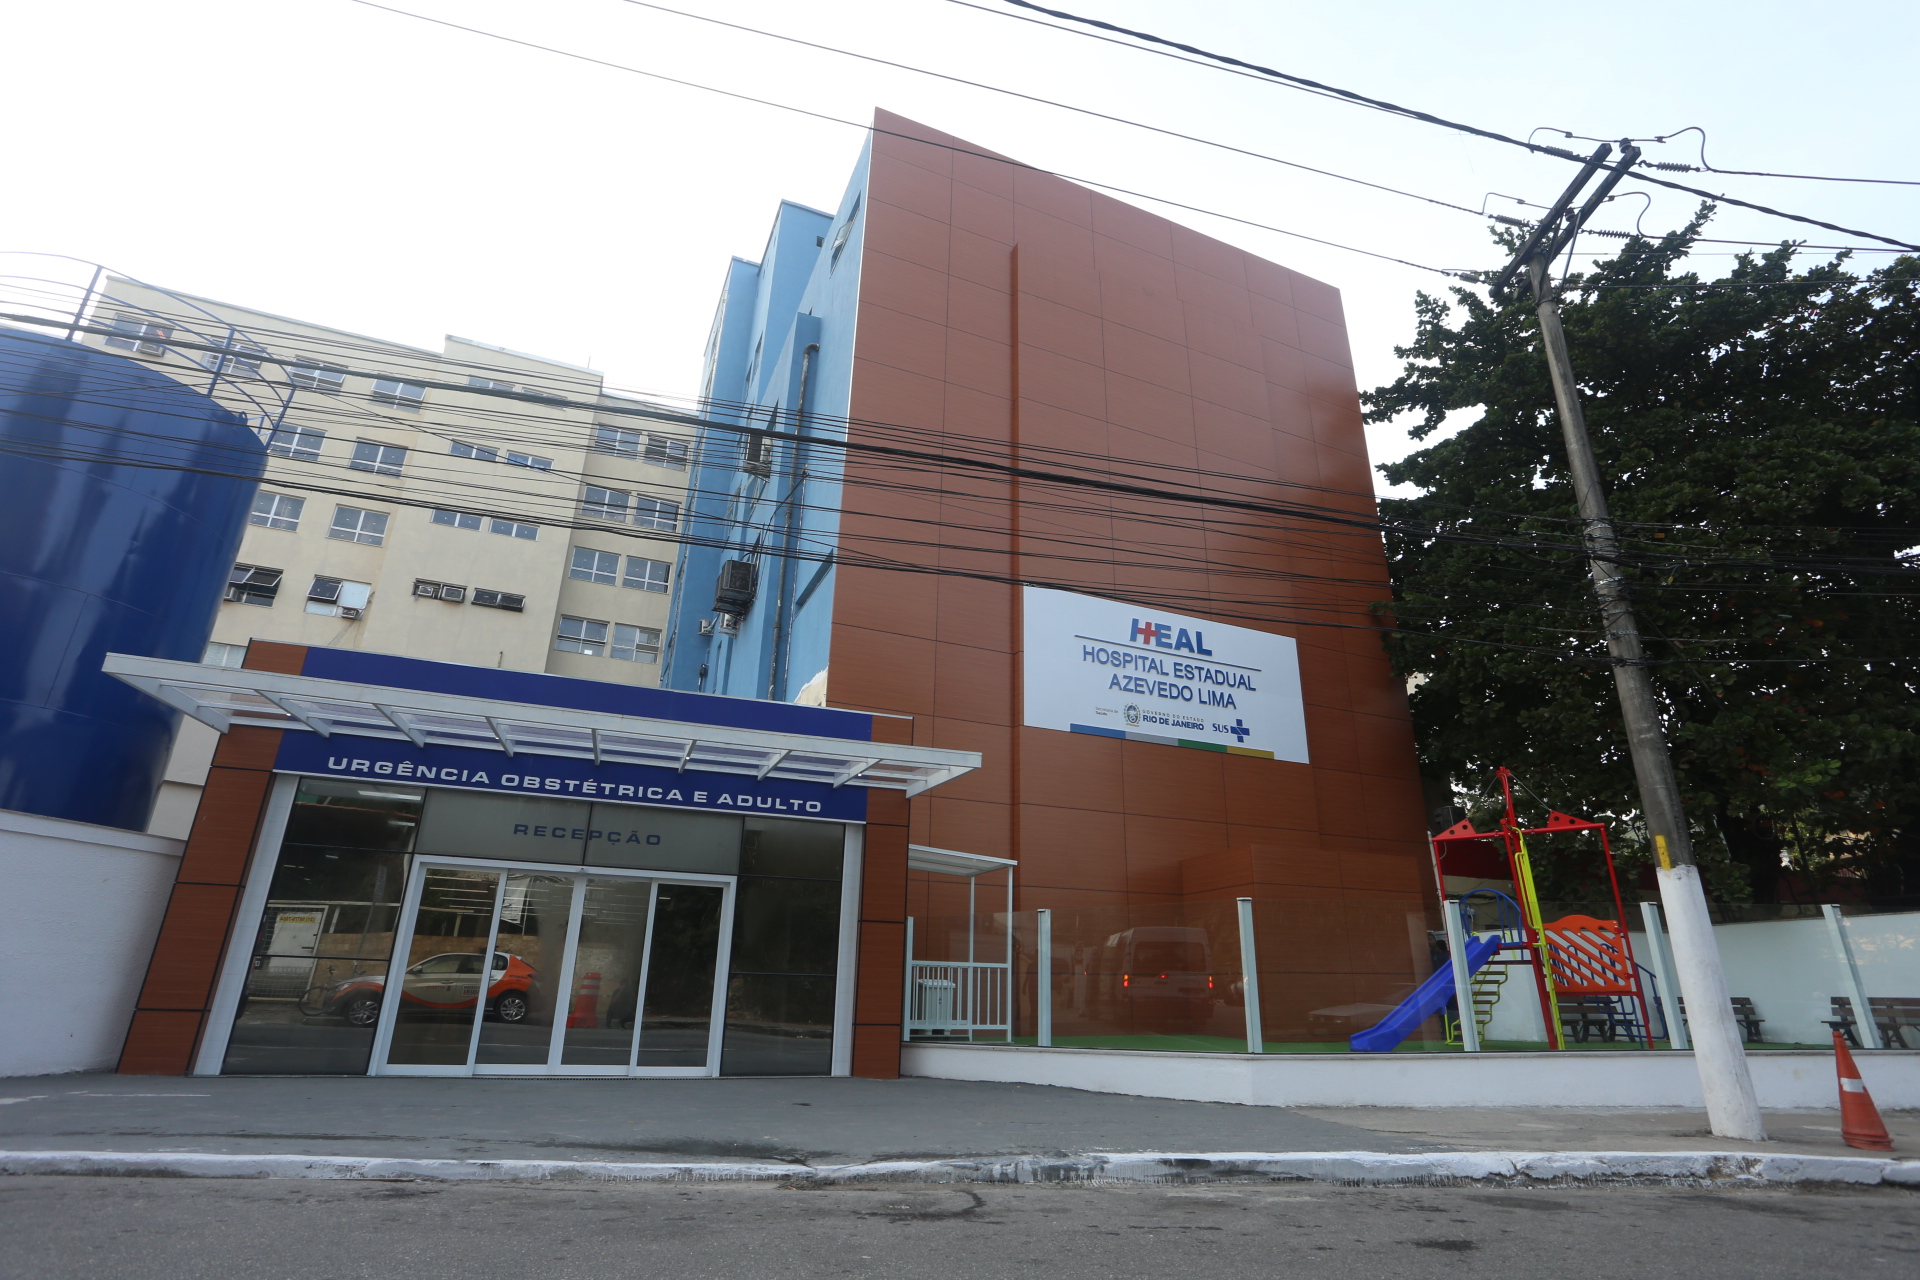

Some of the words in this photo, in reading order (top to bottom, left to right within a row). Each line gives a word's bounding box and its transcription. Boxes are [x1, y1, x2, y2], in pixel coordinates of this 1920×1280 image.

[1130, 618, 1212, 656] HEAL
[1083, 645, 1169, 676] HOSPITAL
[1174, 662, 1256, 691] ESTADUAL
[1109, 674, 1193, 701] AZEVEDO
[1199, 689, 1236, 709] LIMA
[1143, 714, 1157, 723] RIO
[1159, 717, 1169, 725] DE
[1171, 720, 1204, 730] JANEIRO
[1212, 723, 1229, 733] SUS
[327, 756, 489, 784] URGÊNCIA
[500, 773, 683, 802] OBSTÉTRICA
[694, 791, 708, 802] E
[717, 793, 822, 813] ADULTO
[513, 823, 662, 846] RECEPÇÃO
